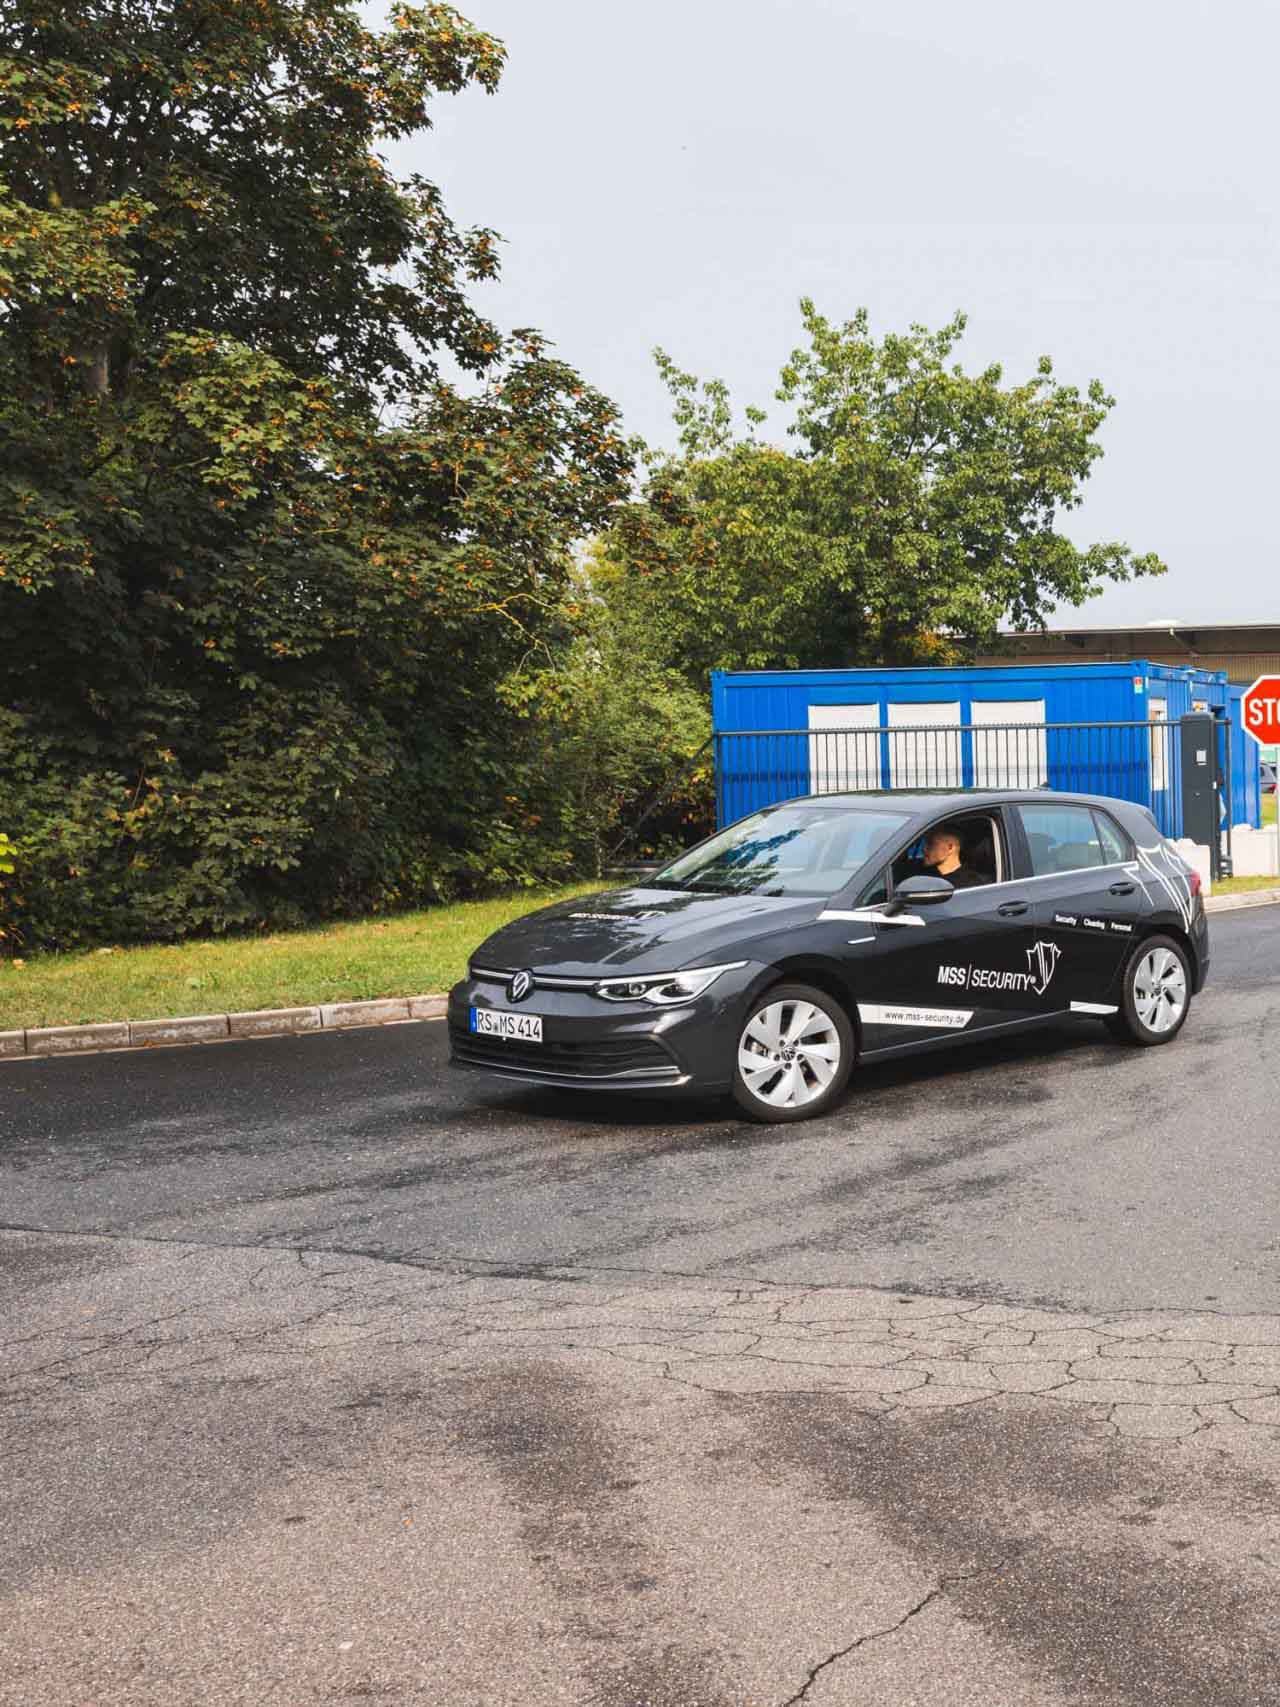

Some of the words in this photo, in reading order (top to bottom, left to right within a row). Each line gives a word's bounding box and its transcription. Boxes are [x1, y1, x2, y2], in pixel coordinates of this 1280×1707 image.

[937, 965, 967, 985] MSS
[971, 969, 1032, 991] SECURITY
[478, 1011, 492, 1031] RS
[500, 1015, 515, 1035] MS
[517, 1018, 540, 1038] 414
[885, 1012, 965, 1024] www.mss-security.de
